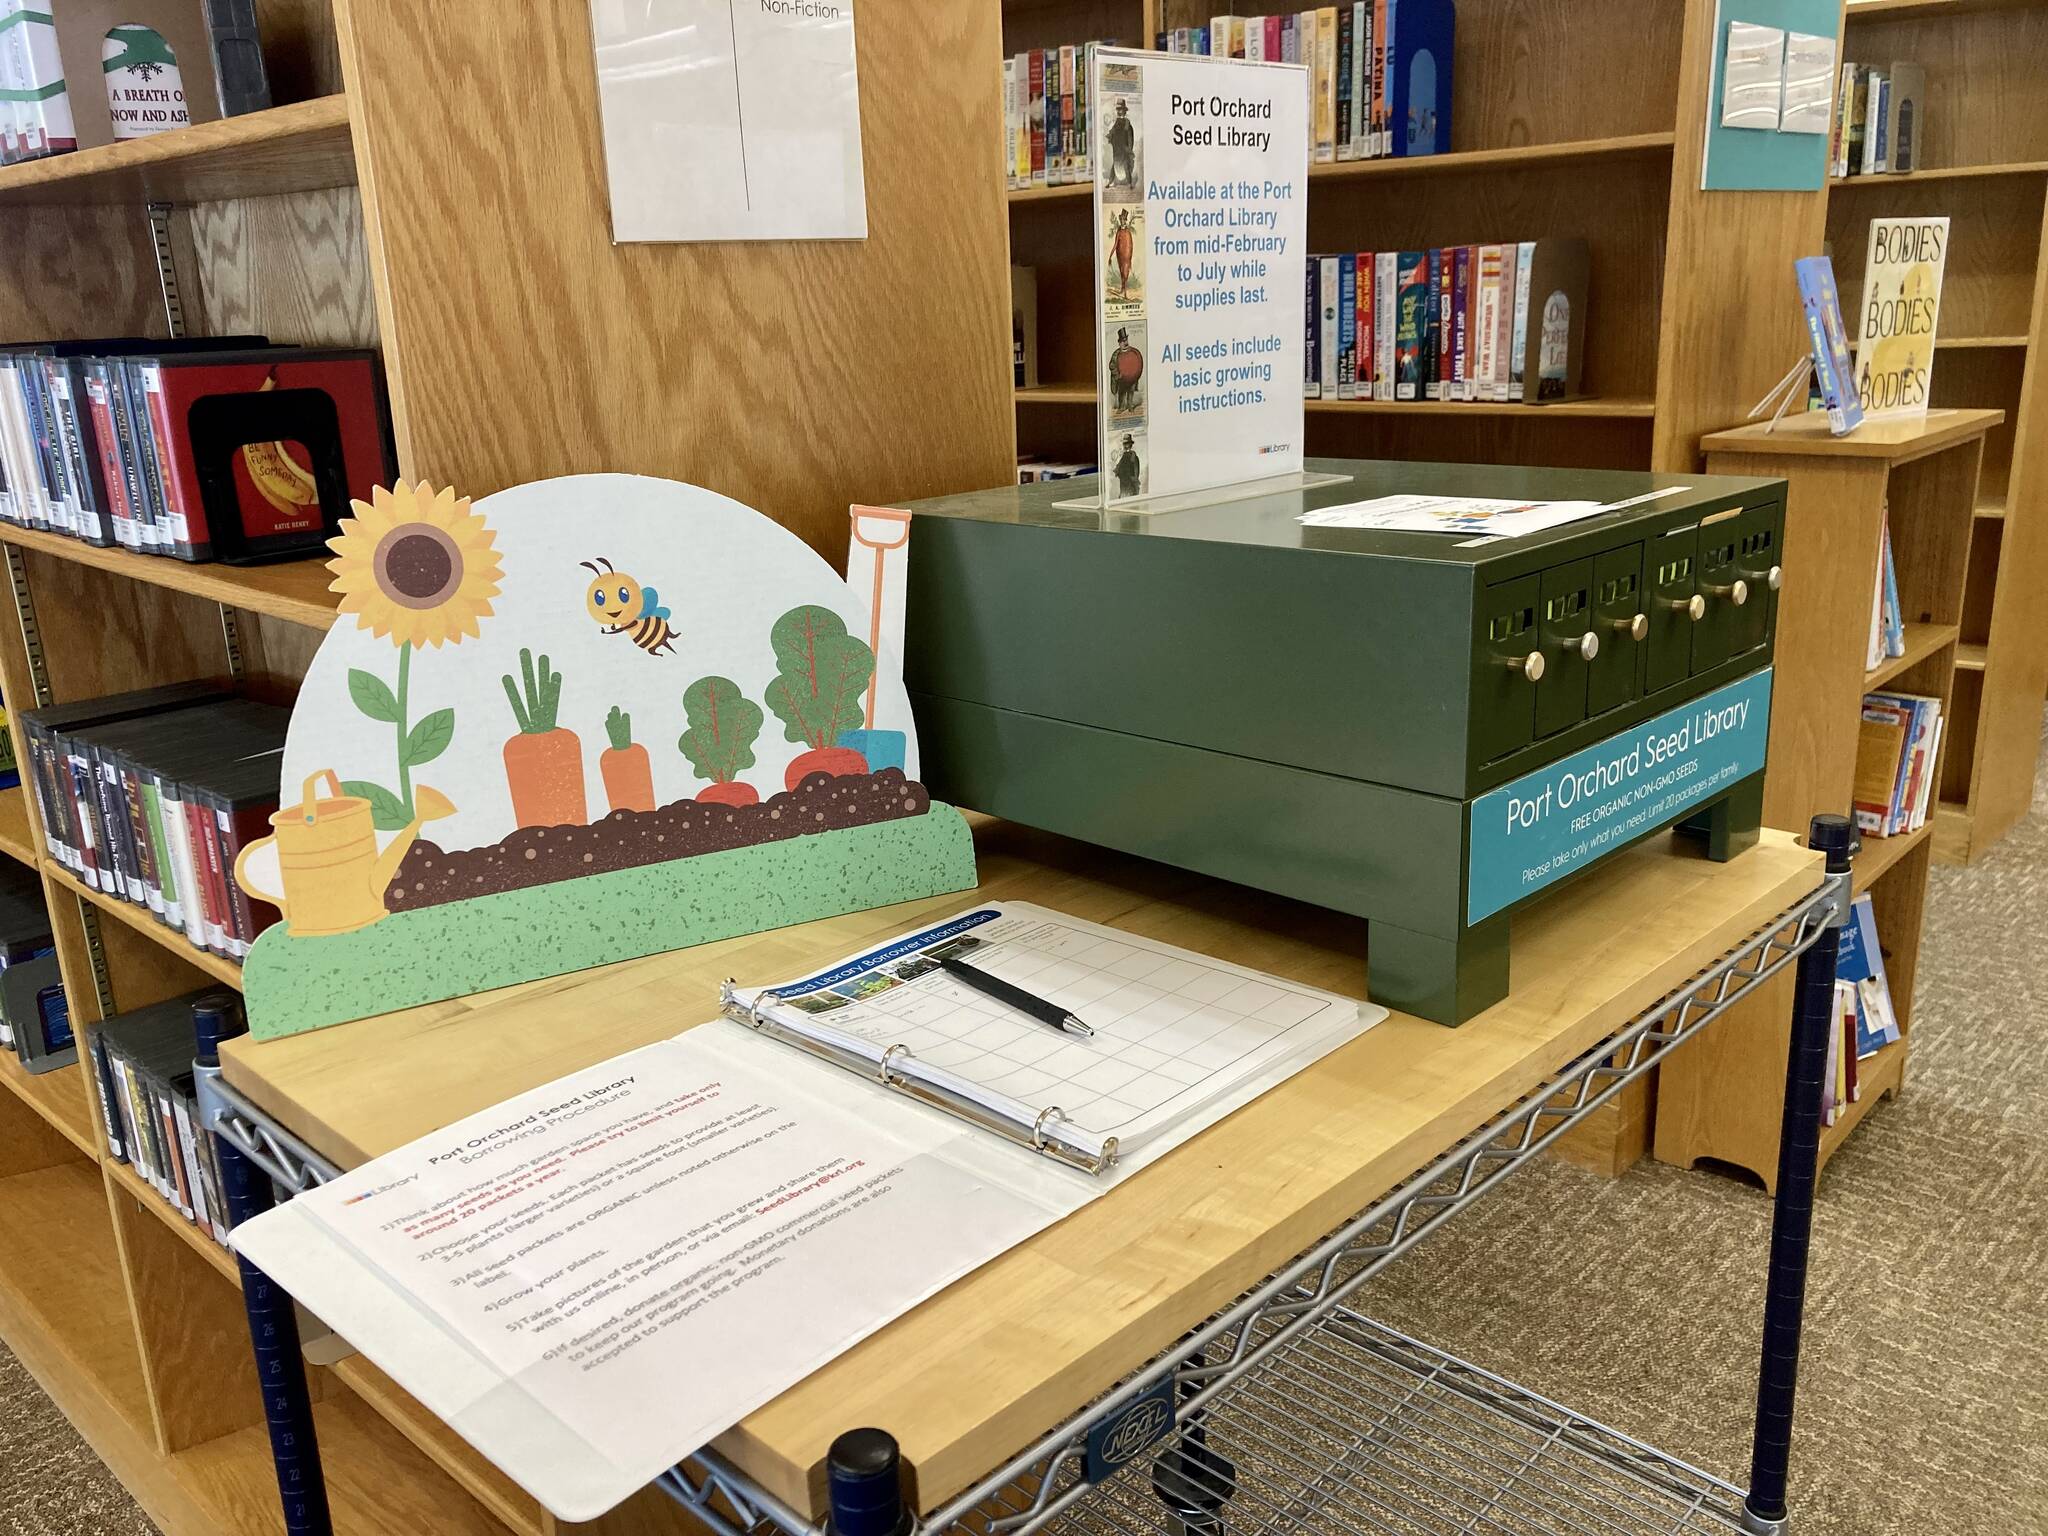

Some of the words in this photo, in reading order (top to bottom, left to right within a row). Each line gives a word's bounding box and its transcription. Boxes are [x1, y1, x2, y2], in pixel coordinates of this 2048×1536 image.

[761, 0, 839, 19] Non-Fiction
[1374, 47, 1383, 101] PATINA
[112, 89, 120, 101] A
[125, 89, 170, 102] BREATH
[173, 90, 186, 102] O
[1172, 94, 1205, 116] Port
[1210, 96, 1272, 120] Orchard
[142, 110, 167, 122] AND
[1173, 124, 1212, 146] Seed
[1218, 126, 1270, 152] Library
[1148, 181, 1216, 200] Available
[1221, 184, 1234, 200] at
[1238, 182, 1260, 199] the
[1264, 181, 1292, 200] Port
[1165, 208, 1224, 228] Orchard
[1230, 208, 1277, 230] Library
[1154, 236, 1188, 255] from
[1194, 234, 1286, 254] mid-February
[1874, 224, 1943, 264] BODIES
[1178, 264, 1192, 282] to
[1196, 262, 1226, 282] July
[1230, 260, 1266, 279] while
[1176, 288, 1236, 312] supplies
[1240, 286, 1268, 304] last.
[1342, 274, 1354, 300] NORA
[1342, 302, 1354, 342] ROBERTS
[1456, 310, 1465, 329] JUST
[1866, 297, 1935, 339] BODIES
[1162, 343, 1181, 364] All
[1186, 340, 1227, 360] seeds
[1232, 334, 1281, 356] include
[1456, 332, 1465, 351] LIKE
[1174, 368, 1211, 388] basic
[1216, 362, 1271, 387] growing
[1305, 340, 1315, 382] Becoming
[1454, 354, 1465, 382] THAT
[1179, 388, 1266, 414] instructions.
[1861, 368, 1926, 411] BODIES
[70, 434, 80, 459] GIRL
[250, 453, 278, 465] FUNNY
[260, 466, 296, 488] SOMEDAY
[274, 521, 290, 530] KATIE
[1506, 783, 1552, 836] Port
[1558, 743, 1640, 808] Orchard
[1645, 719, 1690, 768] Seed
[1694, 699, 1750, 745] Library
[1570, 812, 1592, 834] FREE
[1592, 792, 1632, 823] ORGANIC
[1634, 772, 1676, 806] NON-GMO
[1676, 759, 1698, 782] SEEDS
[1522, 862, 1550, 884] Please
[1552, 852, 1570, 869] take
[1571, 842, 1588, 861] only
[1590, 830, 1610, 847] what
[1610, 824, 1625, 840] you
[1648, 801, 1664, 818] Limit
[1665, 796, 1675, 810] 20
[1676, 782, 1707, 806] packages
[1707, 774, 1720, 790] per
[1720, 762, 1738, 784] family
[776, 982, 816, 998] Seed
[816, 964, 863, 990] Library
[867, 941, 921, 966] Borrower
[921, 912, 992, 943] Information
[428, 1147, 464, 1165] Port
[467, 1115, 537, 1148] Orchard
[538, 1097, 582, 1117] Seed
[582, 1076, 635, 1100] Library
[459, 1126, 546, 1164] Borrowing
[546, 1090, 631, 1126] Procedure
[431, 1192, 467, 1211] about
[466, 1179, 494, 1193] how
[496, 1164, 528, 1180] much
[530, 1146, 569, 1165] garden
[570, 1132, 601, 1147] space
[602, 1122, 623, 1133] you
[622, 1112, 652, 1124] have,
[654, 1101, 674, 1111] and
[673, 1092, 697, 1103] take
[699, 1082, 721, 1093] only
[420, 1208, 455, 1226] many
[457, 1191, 492, 1209] seeds
[508, 1173, 532, 1185] you
[533, 1158, 567, 1173] need.
[569, 1139, 607, 1156] Please
[606, 1131, 625, 1140] try
[637, 1115, 665, 1127] limit
[664, 1097, 706, 1116] yourself
[371, 1173, 418, 1195] Library
[413, 1217, 458, 1239] around
[478, 1187, 524, 1211] packets
[534, 1169, 565, 1184] year.
[532, 1317, 563, 1333] with
[582, 1284, 626, 1307] online,
[641, 1251, 687, 1276] person,
[701, 1232, 720, 1242] via
[721, 1214, 756, 1233] email:
[756, 1161, 865, 1215] SeedLibrary@krl.org
[555, 1278, 606, 1309] pictures
[622, 1258, 645, 1271] the
[645, 1236, 687, 1261] garden
[687, 1223, 714, 1237] that
[712, 1211, 736, 1225] you
[736, 1197, 764, 1214] grew
[765, 1184, 787, 1198] and
[787, 1171, 817, 1187] share
[816, 1158, 845, 1172] them
[535, 1270, 564, 1288] your
[567, 1250, 608, 1272] plants.
